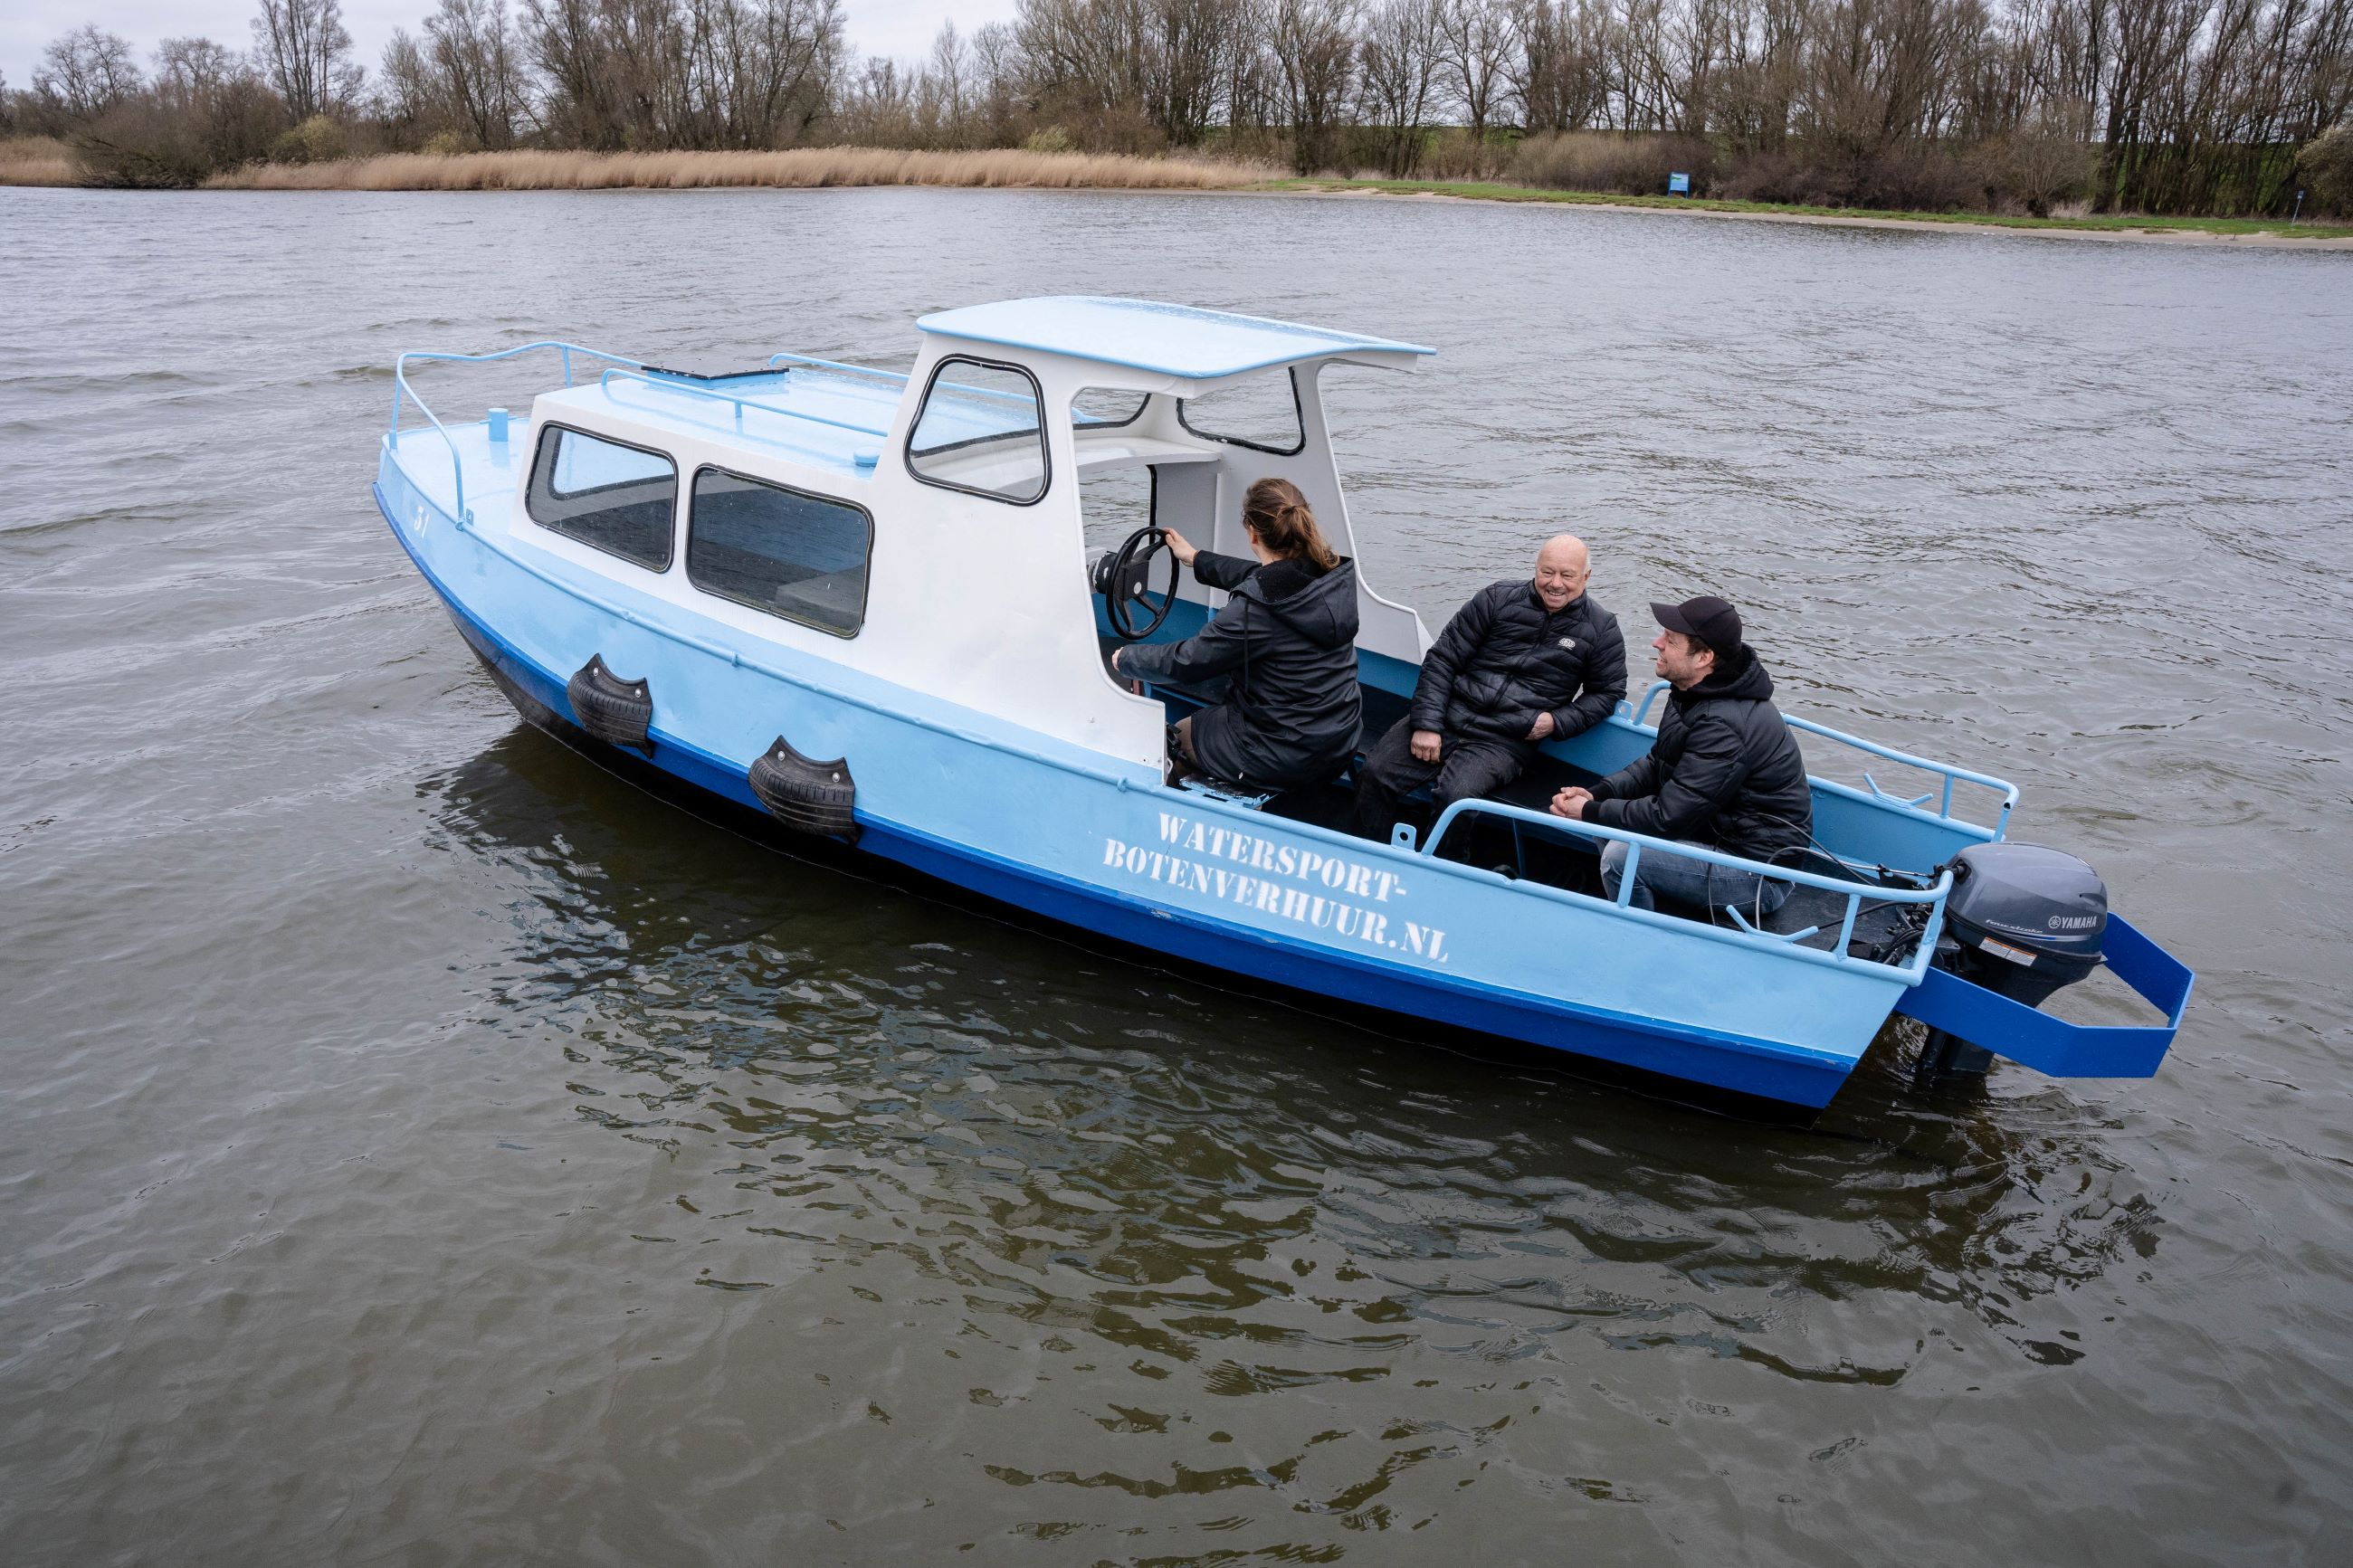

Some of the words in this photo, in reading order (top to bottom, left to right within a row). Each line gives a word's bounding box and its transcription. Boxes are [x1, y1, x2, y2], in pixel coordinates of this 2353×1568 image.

[1102, 838, 1449, 964] BOTENVERHUUR.NL
[1158, 813, 1407, 902] WATERSPORT-
[2062, 916, 2097, 929] YAMAHA
